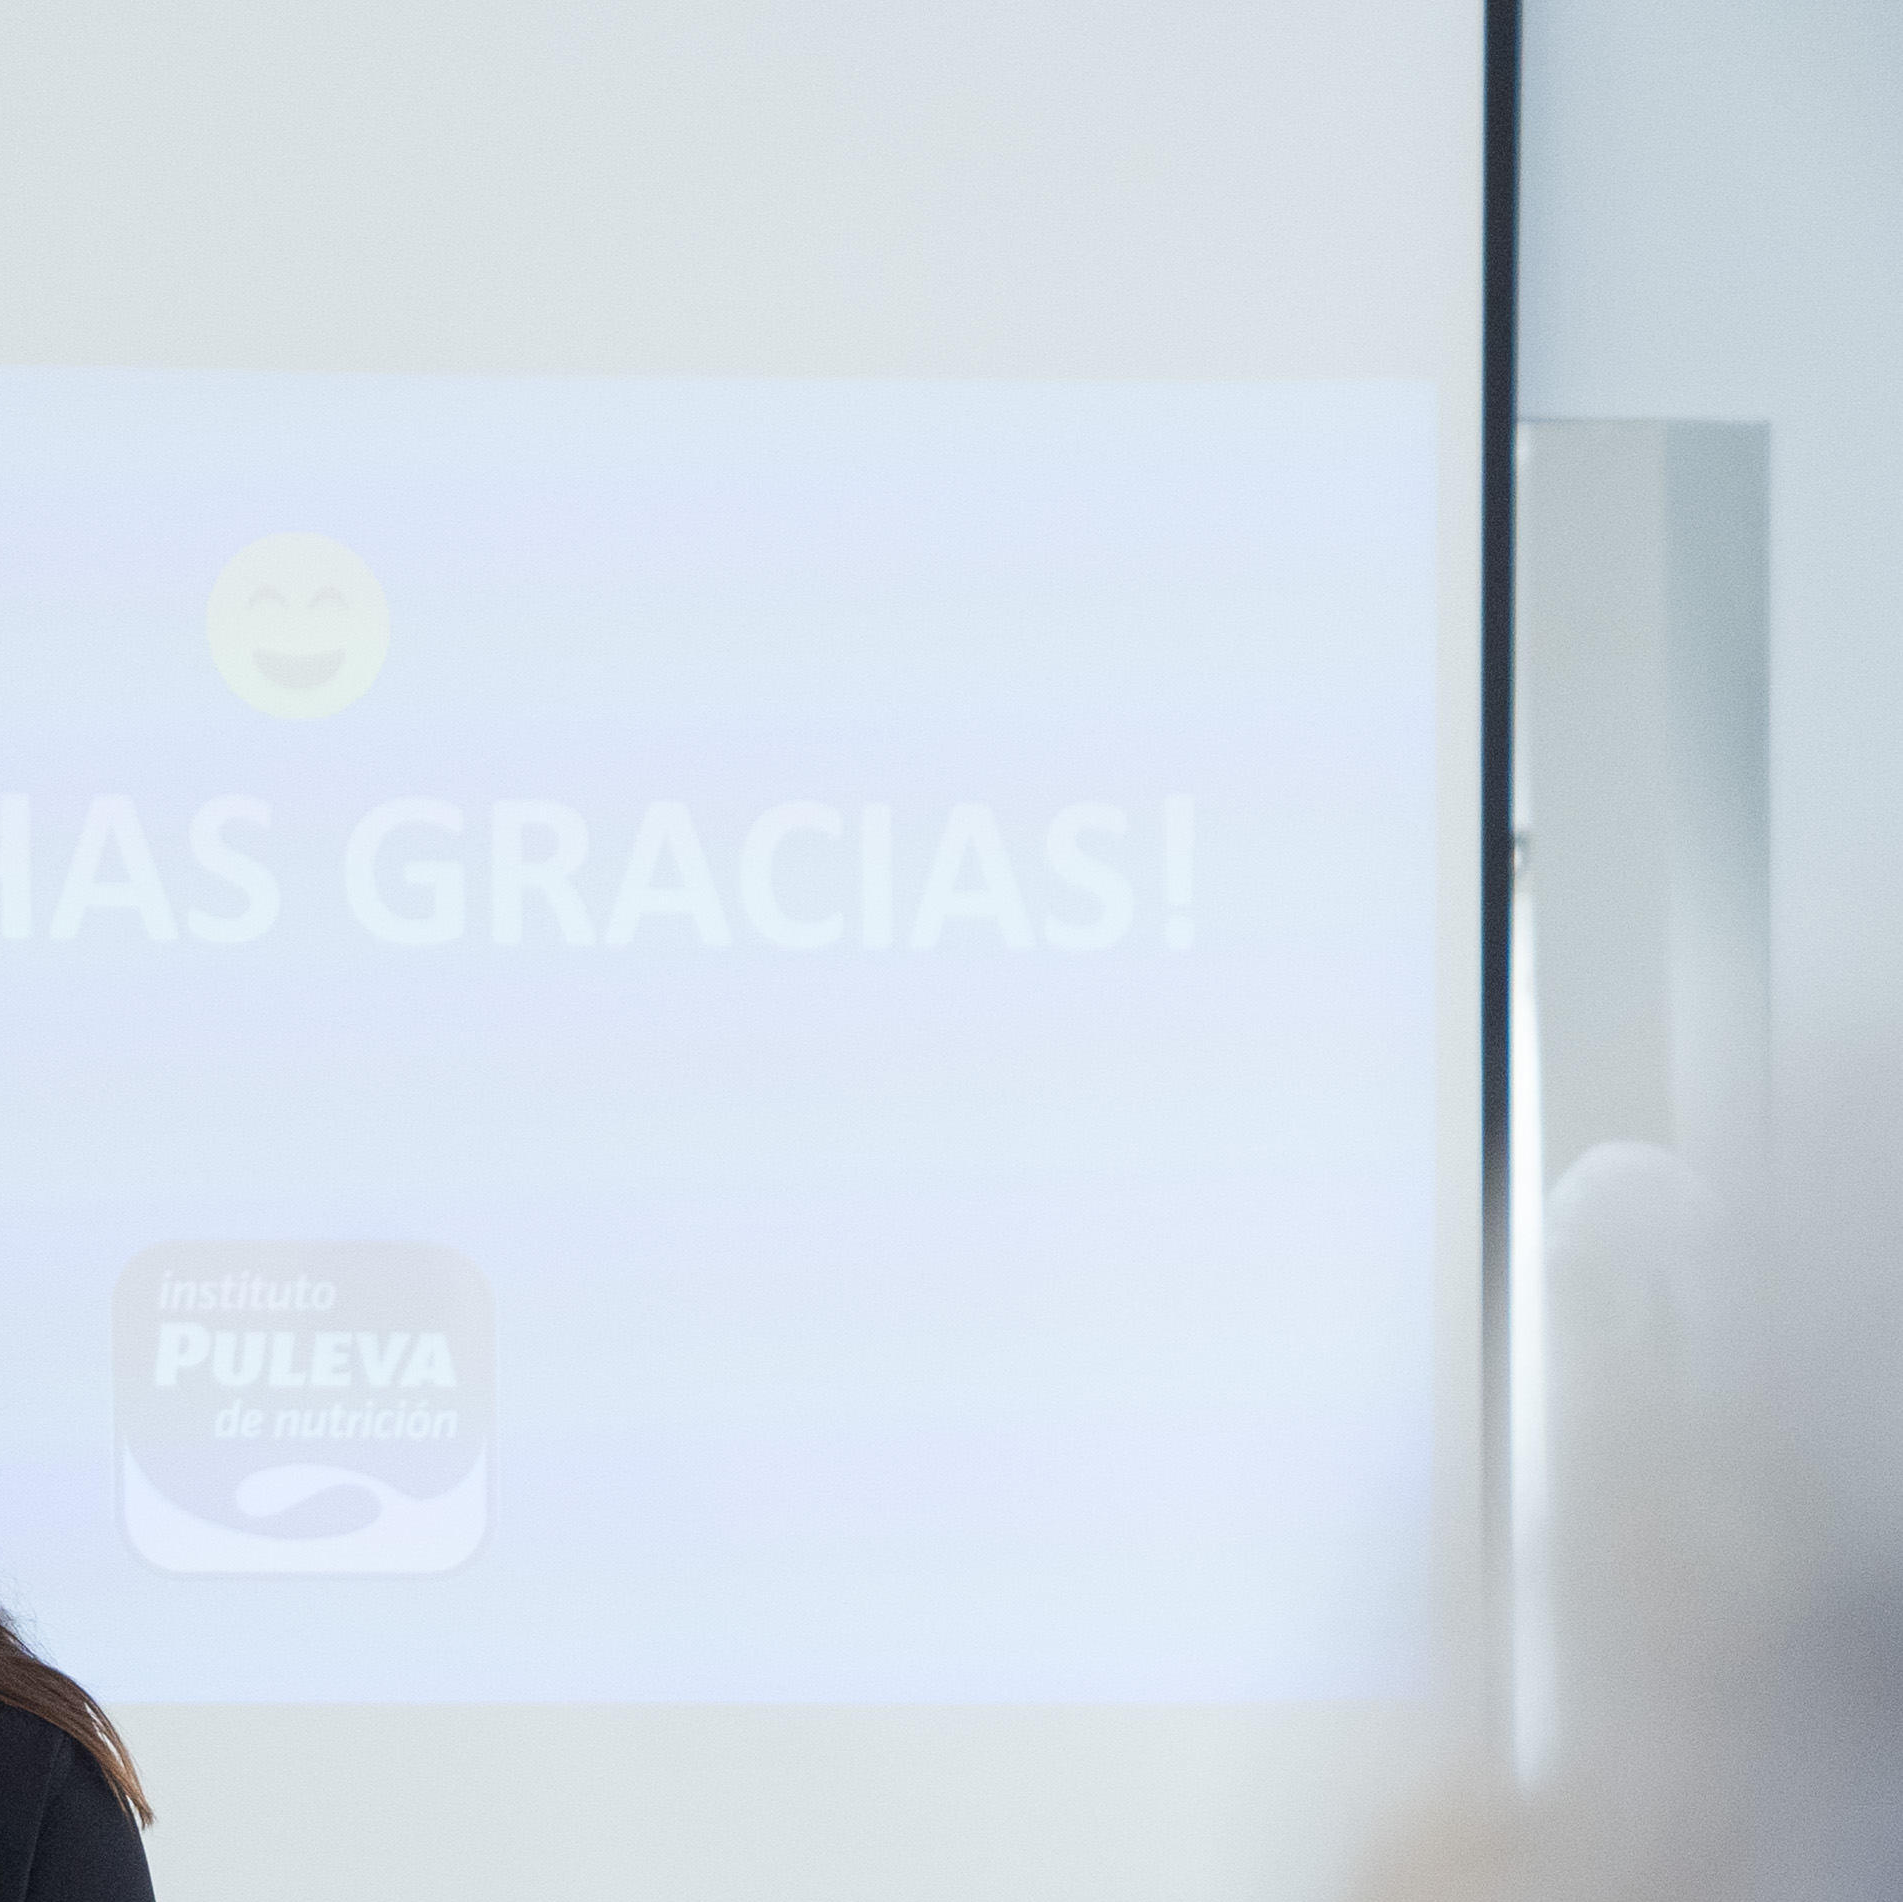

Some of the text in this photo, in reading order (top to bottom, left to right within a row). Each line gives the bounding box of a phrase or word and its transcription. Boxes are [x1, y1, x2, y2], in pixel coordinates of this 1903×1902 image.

[342, 787, 1196, 951] GRACIAS!
[157, 1269, 337, 1311] instituto
[153, 1321, 458, 1388] PULEVA
[213, 1398, 458, 1440] de nutrición
